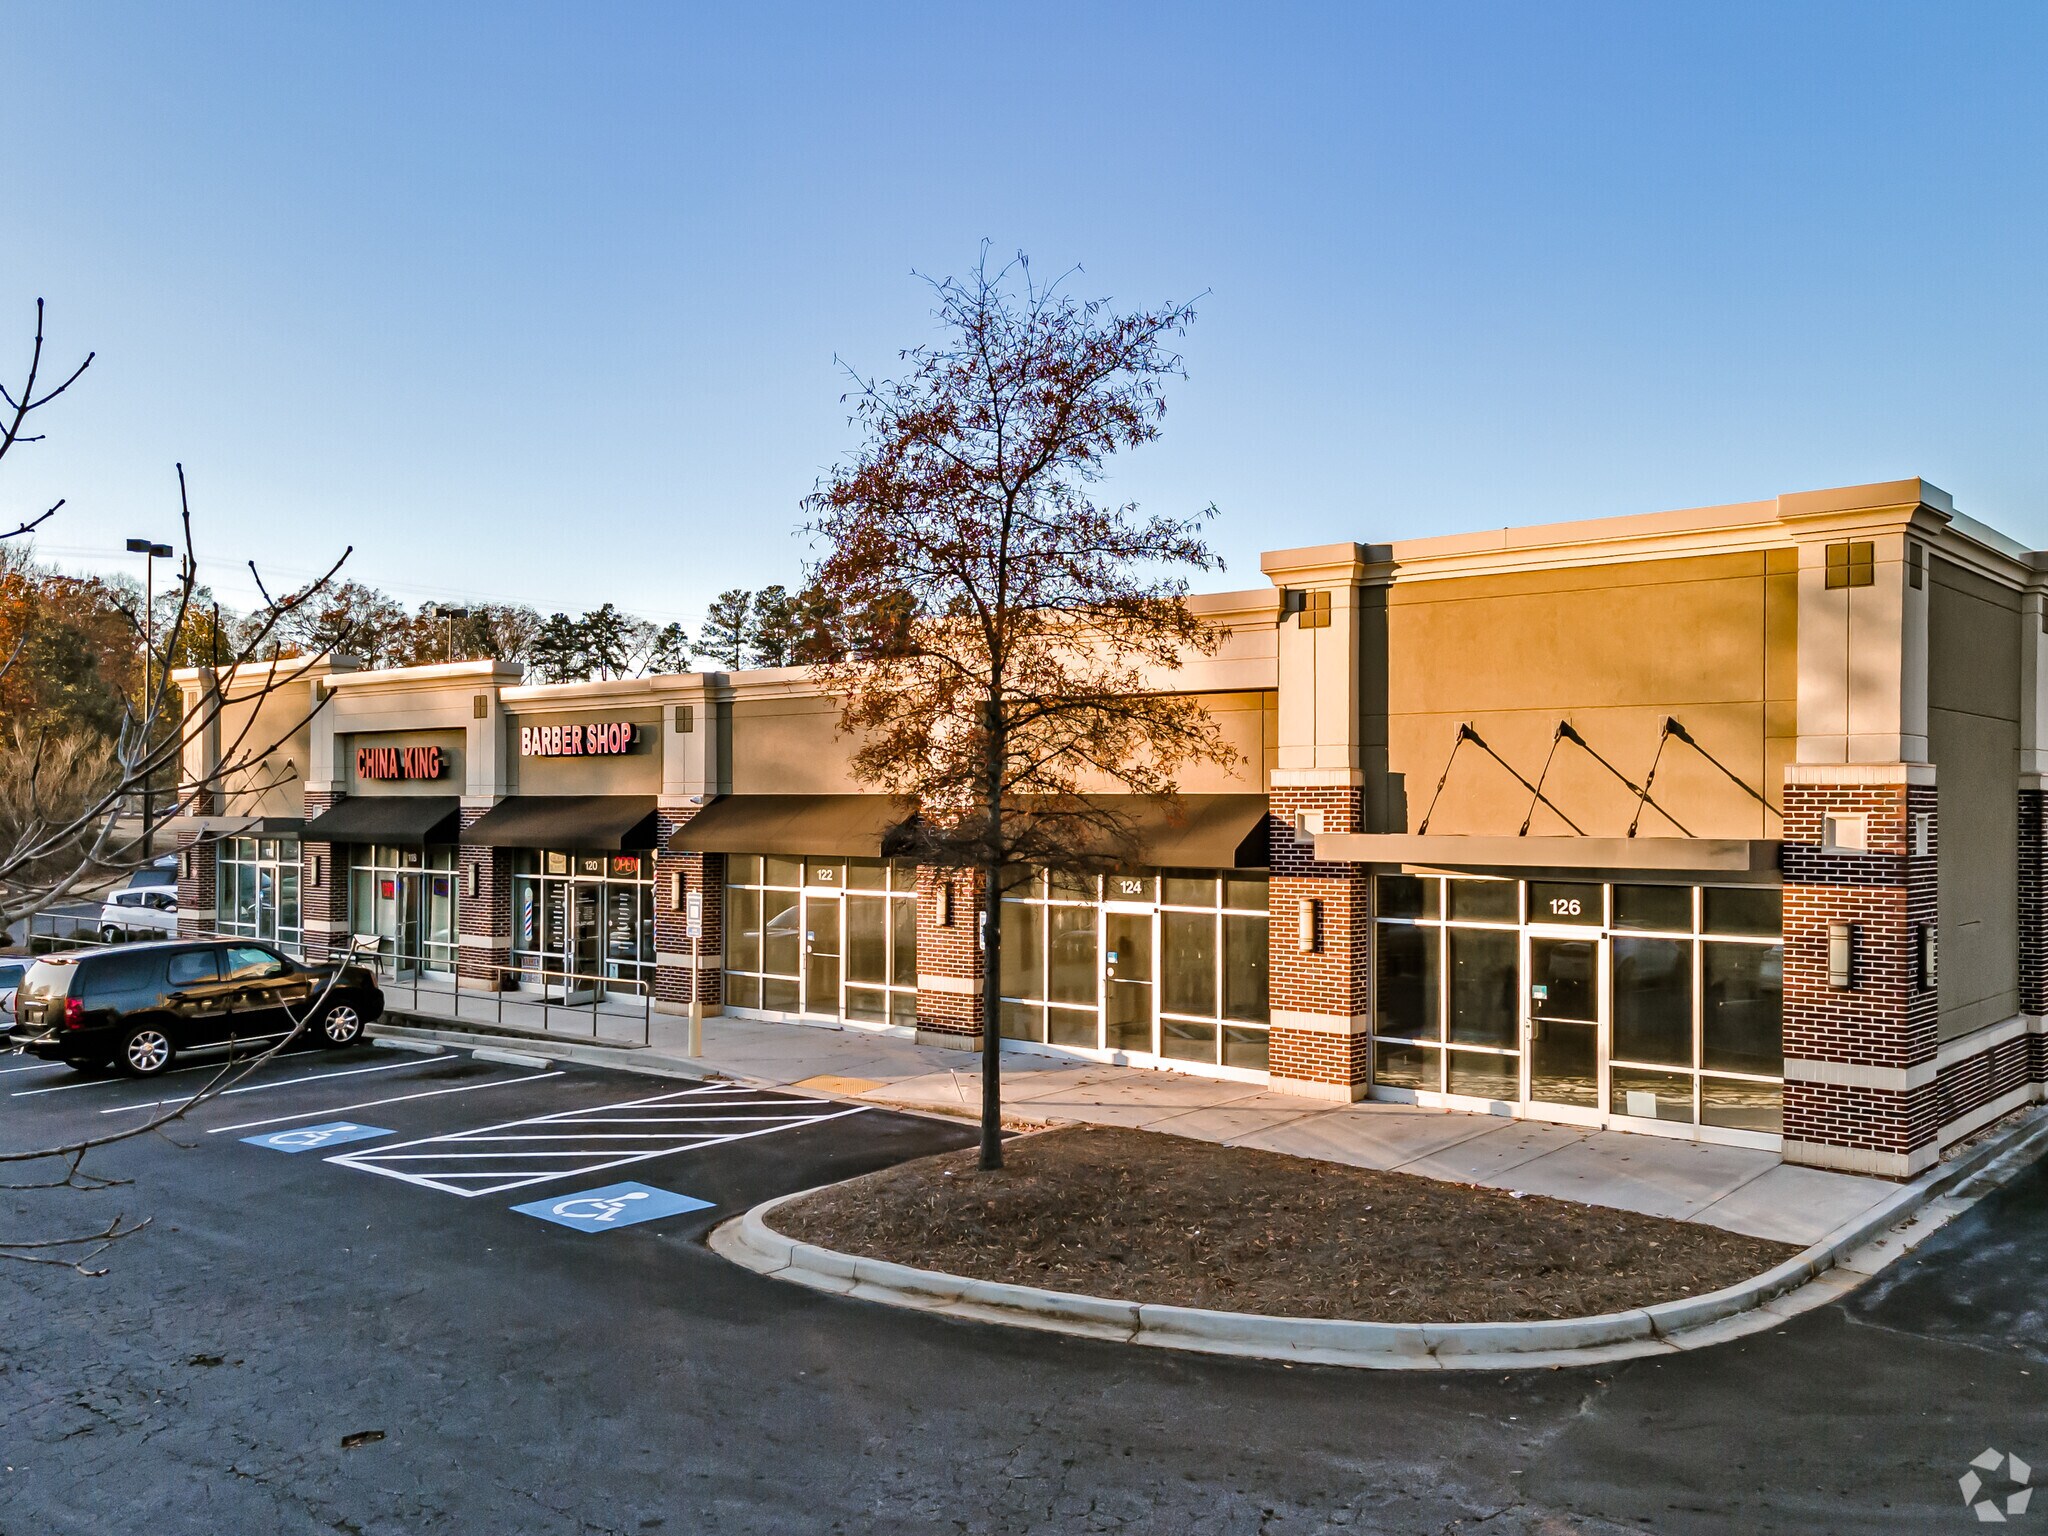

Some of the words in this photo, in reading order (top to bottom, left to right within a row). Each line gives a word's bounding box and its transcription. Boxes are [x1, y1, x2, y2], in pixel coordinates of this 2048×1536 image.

[521, 725, 583, 756] BARBER
[586, 722, 632, 754] SHOP
[356, 747, 399, 779] CHINA
[403, 746, 439, 779] KING
[584, 860, 598, 871] 120
[613, 856, 638, 871] OPEN
[816, 869, 833, 880] 122
[1120, 880, 1142, 894] 124
[1549, 898, 1581, 915] 126
